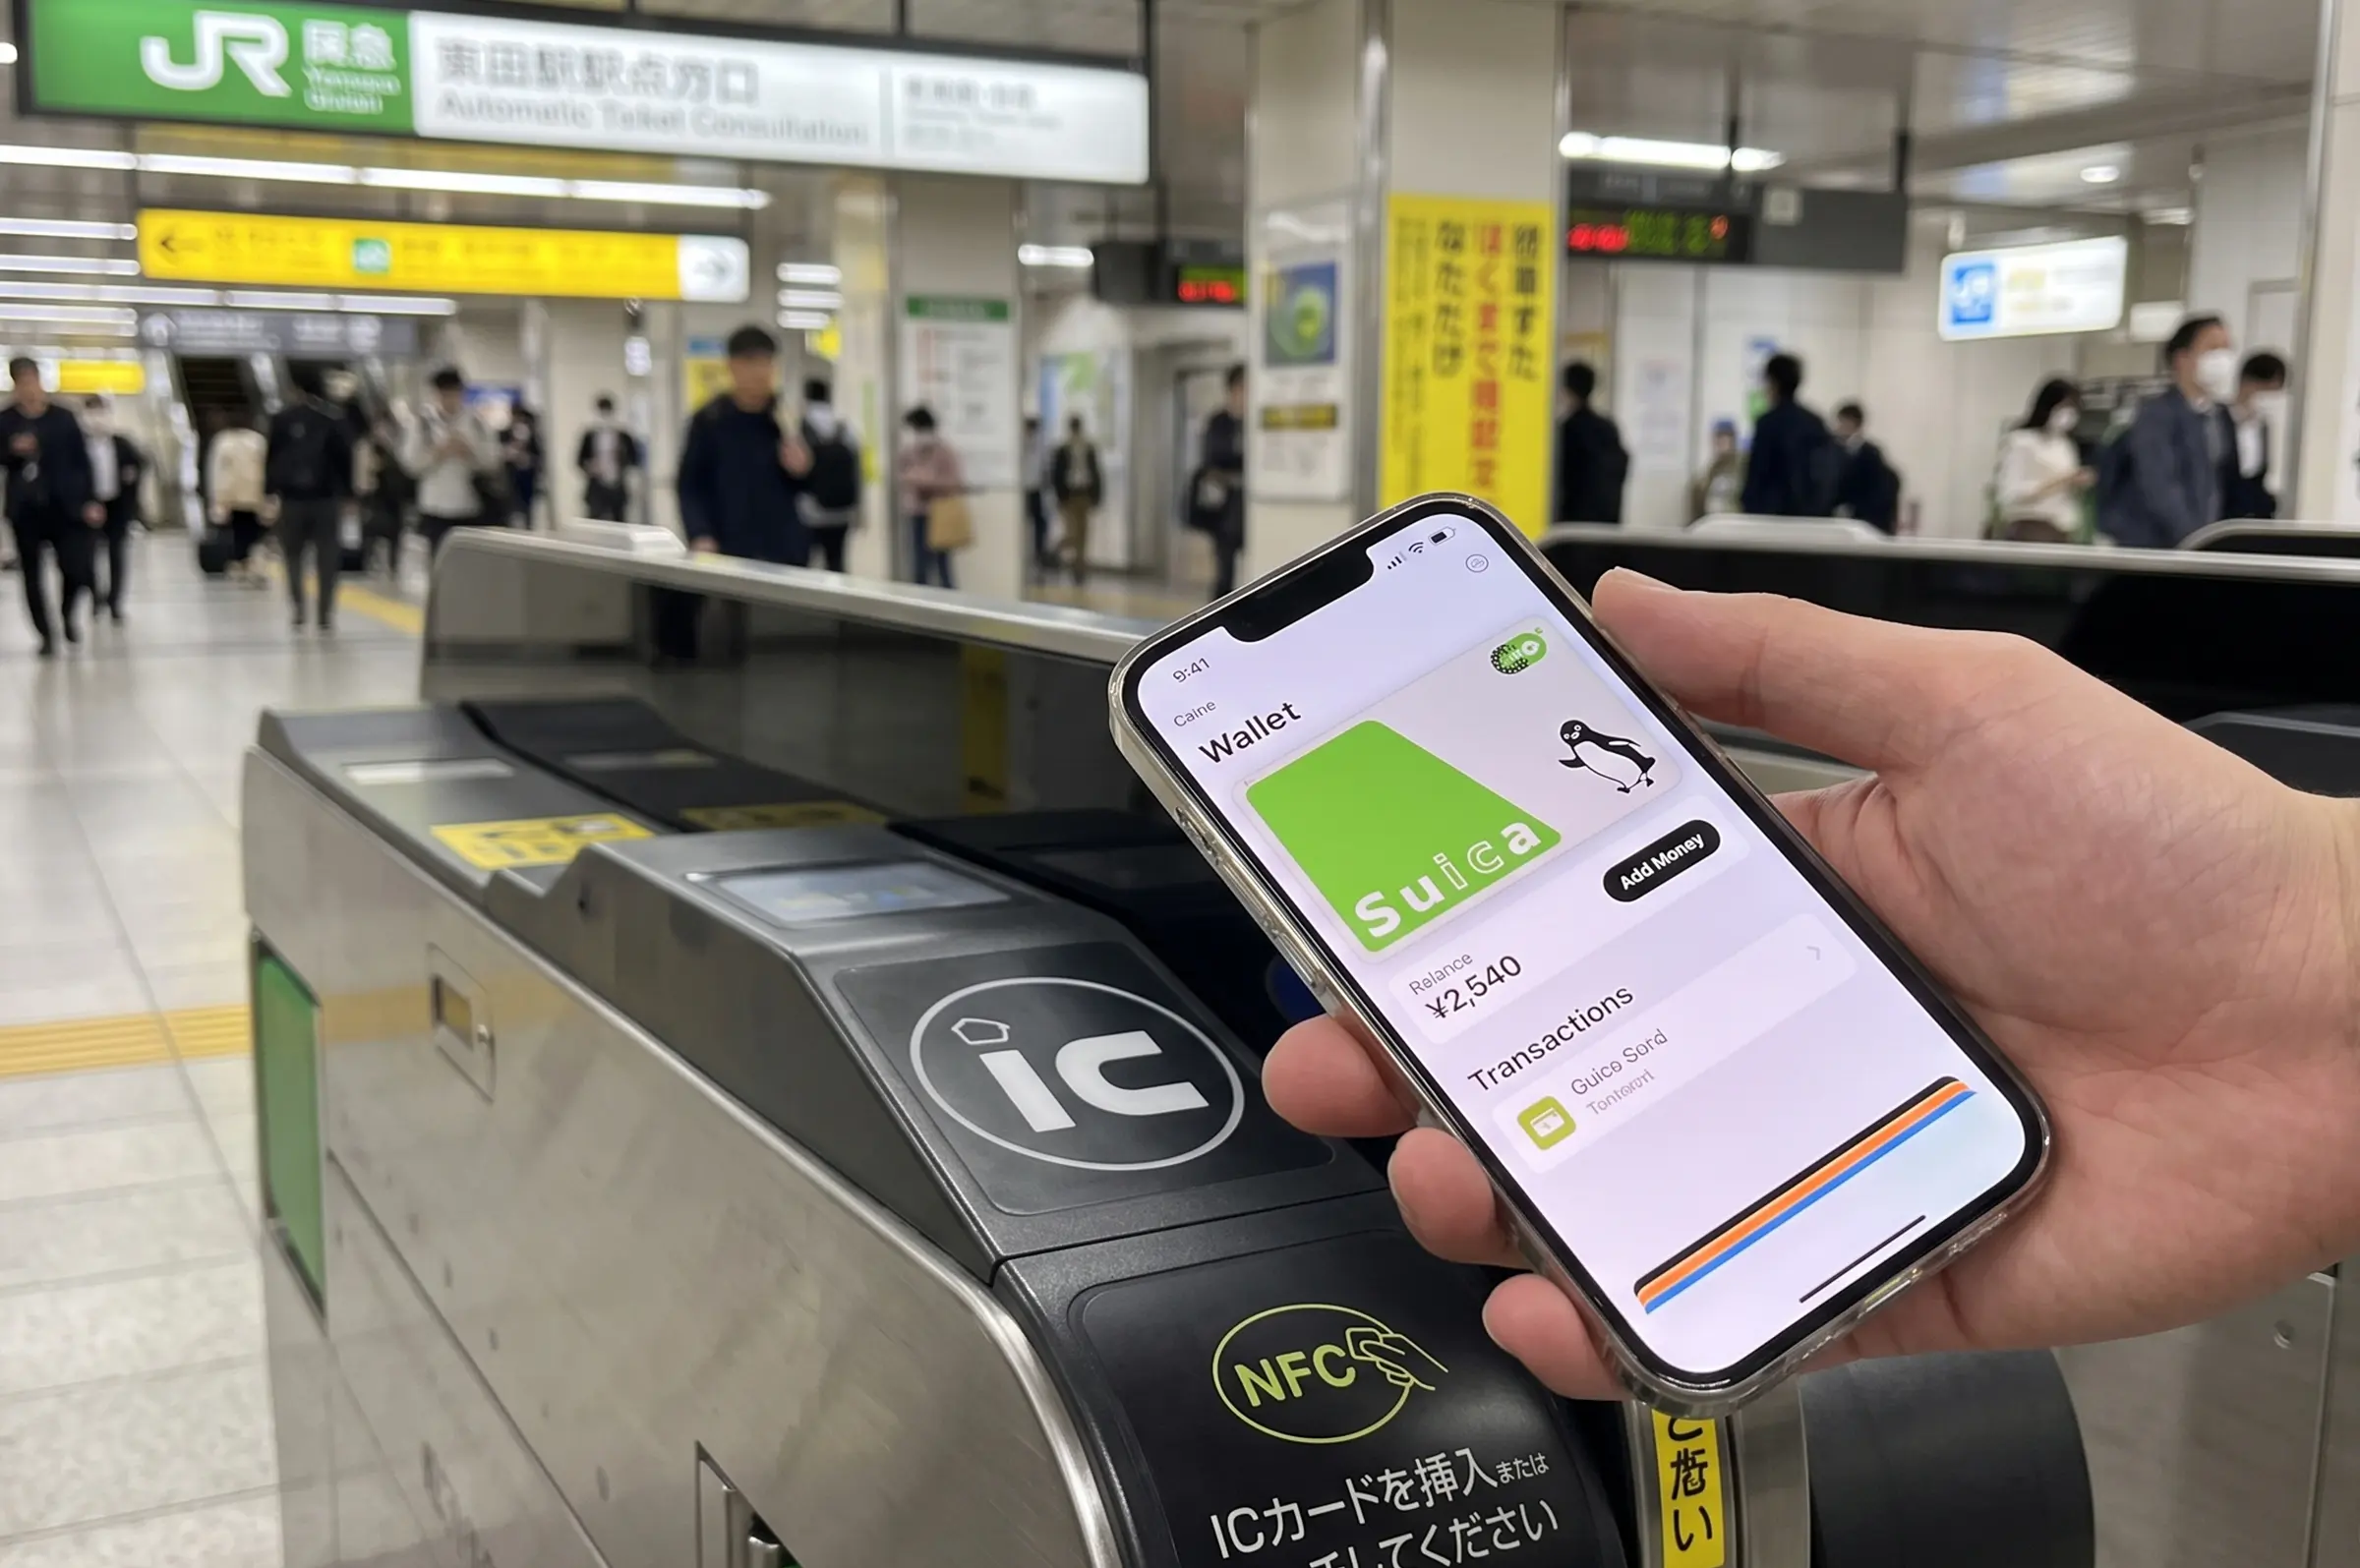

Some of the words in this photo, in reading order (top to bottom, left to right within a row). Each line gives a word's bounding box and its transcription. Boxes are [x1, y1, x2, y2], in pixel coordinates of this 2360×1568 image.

[140, 10, 292, 97] JR
[1173, 658, 1210, 682] 9:41
[1174, 701, 1215, 726] Caine
[1198, 702, 1301, 764] Wallet
[1355, 822, 1541, 938] Suica
[1620, 861, 1654, 891] Add
[1650, 833, 1705, 870] Money
[1425, 956, 1521, 1018] ¥2,540
[1467, 987, 1633, 1091] Transactions
[1234, 1344, 1356, 1407] NFC
